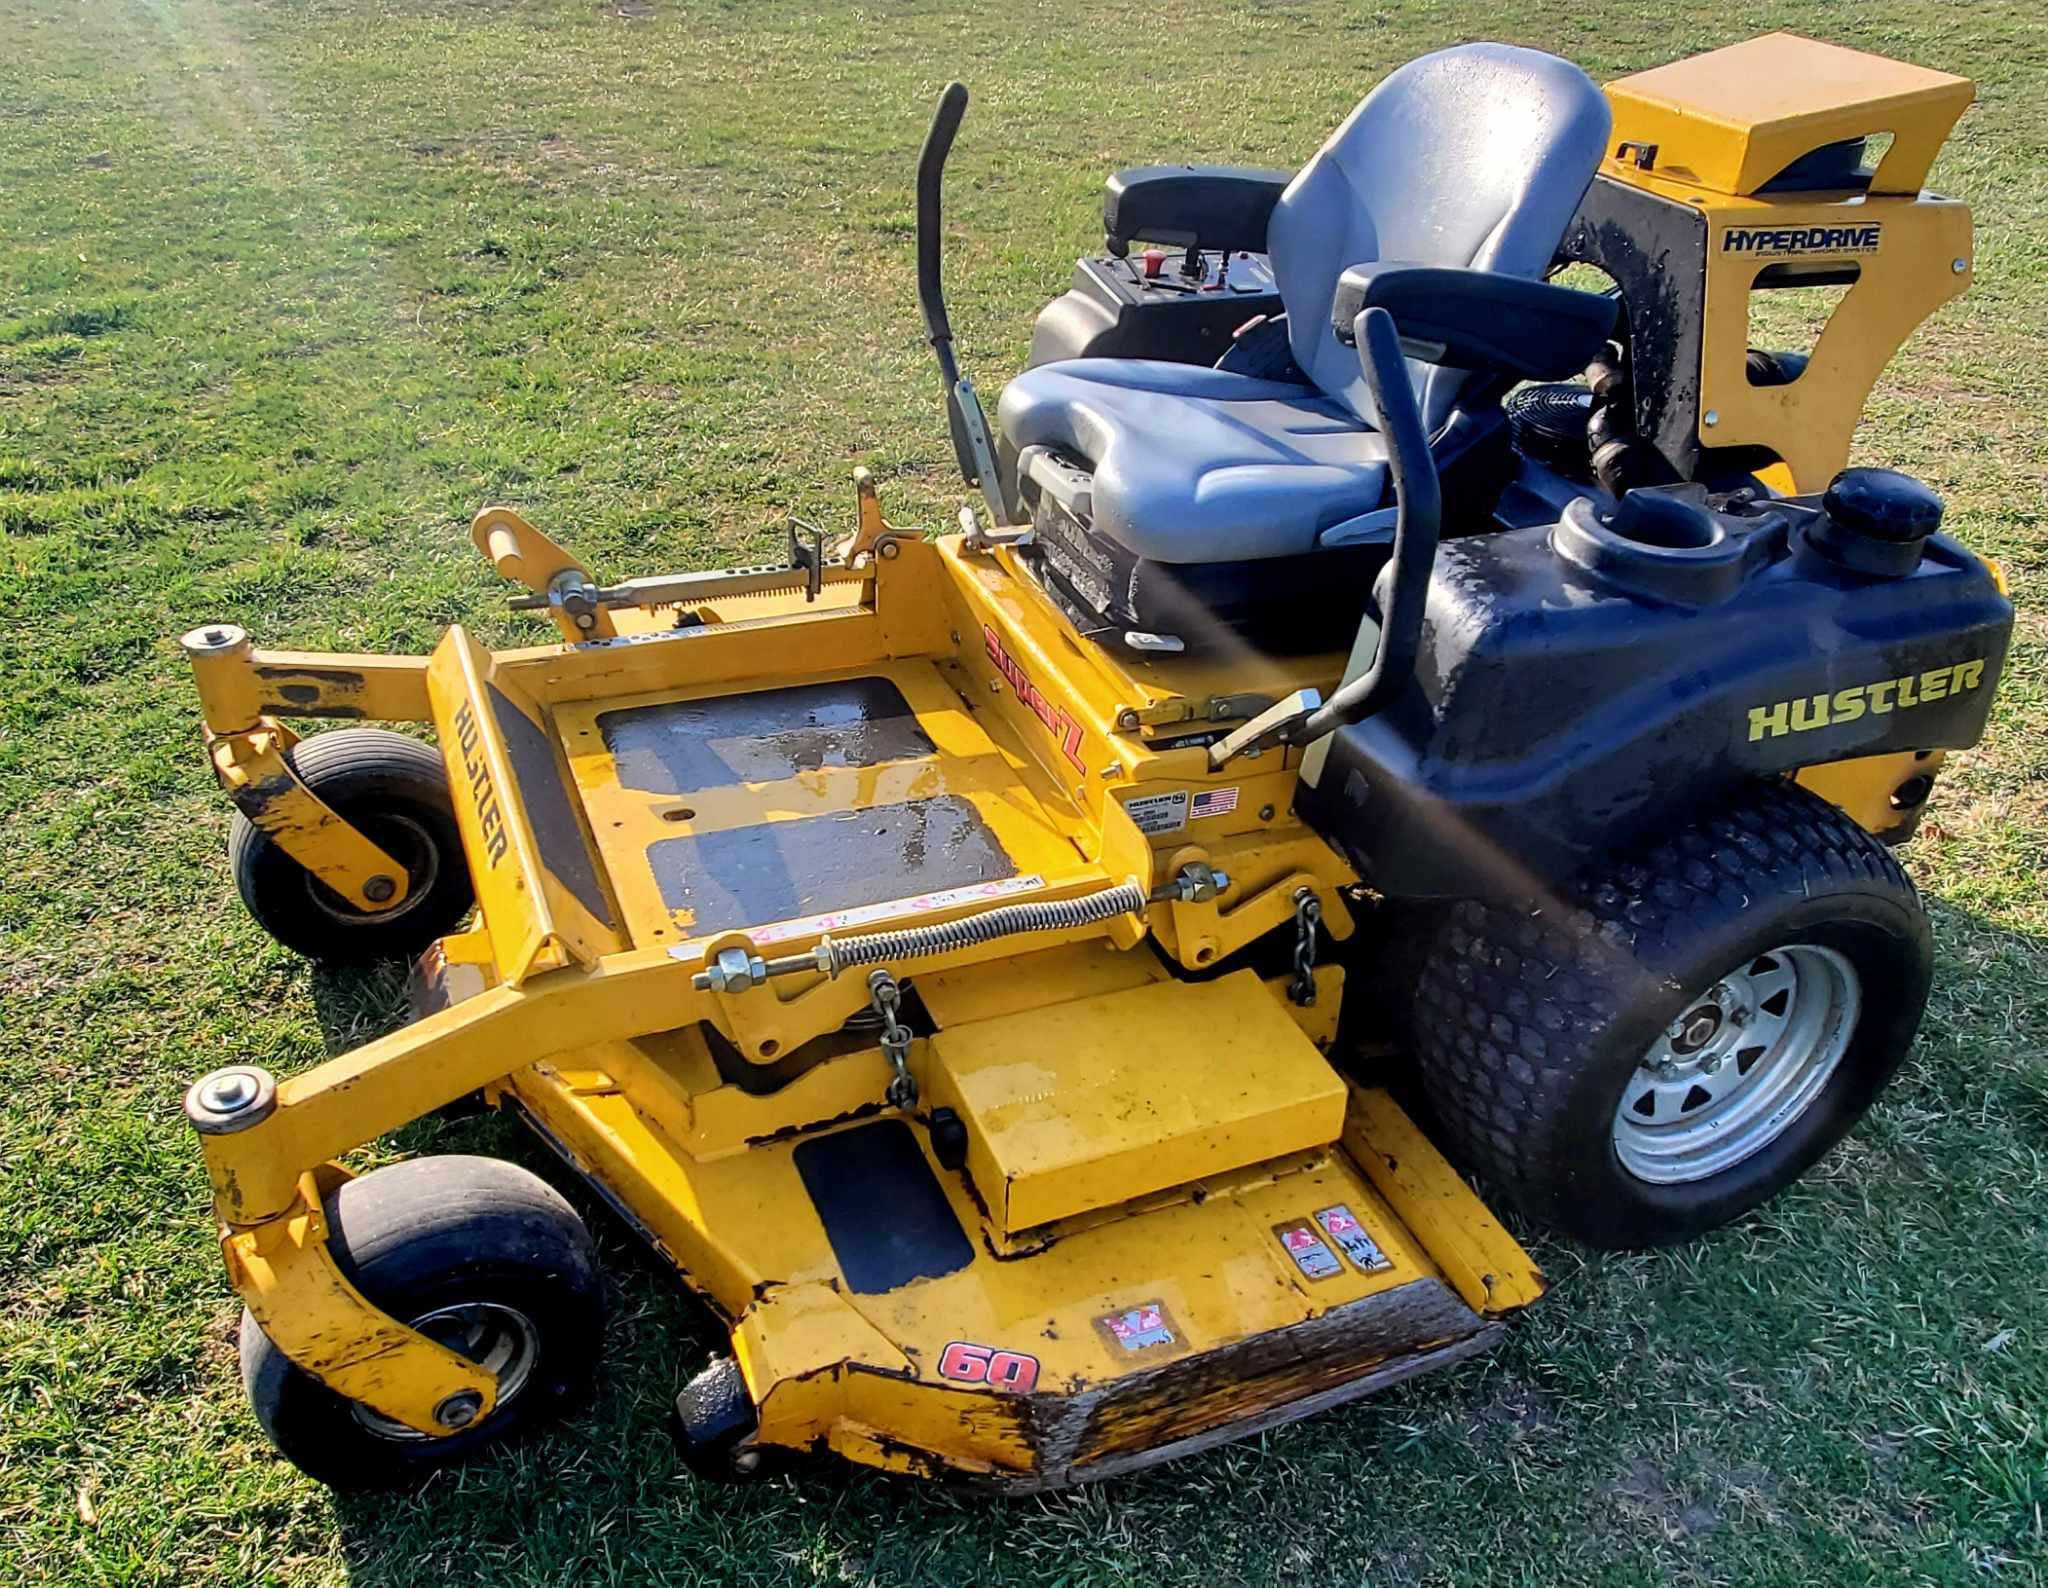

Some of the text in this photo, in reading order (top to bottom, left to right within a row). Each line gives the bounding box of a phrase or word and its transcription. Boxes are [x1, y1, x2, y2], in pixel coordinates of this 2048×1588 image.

[1723, 228, 1880, 251] HYPERDRIVE
[1748, 658, 1985, 742] HUSTLER
[455, 698, 508, 870] HUSTLER
[938, 1341, 1040, 1395] 60
